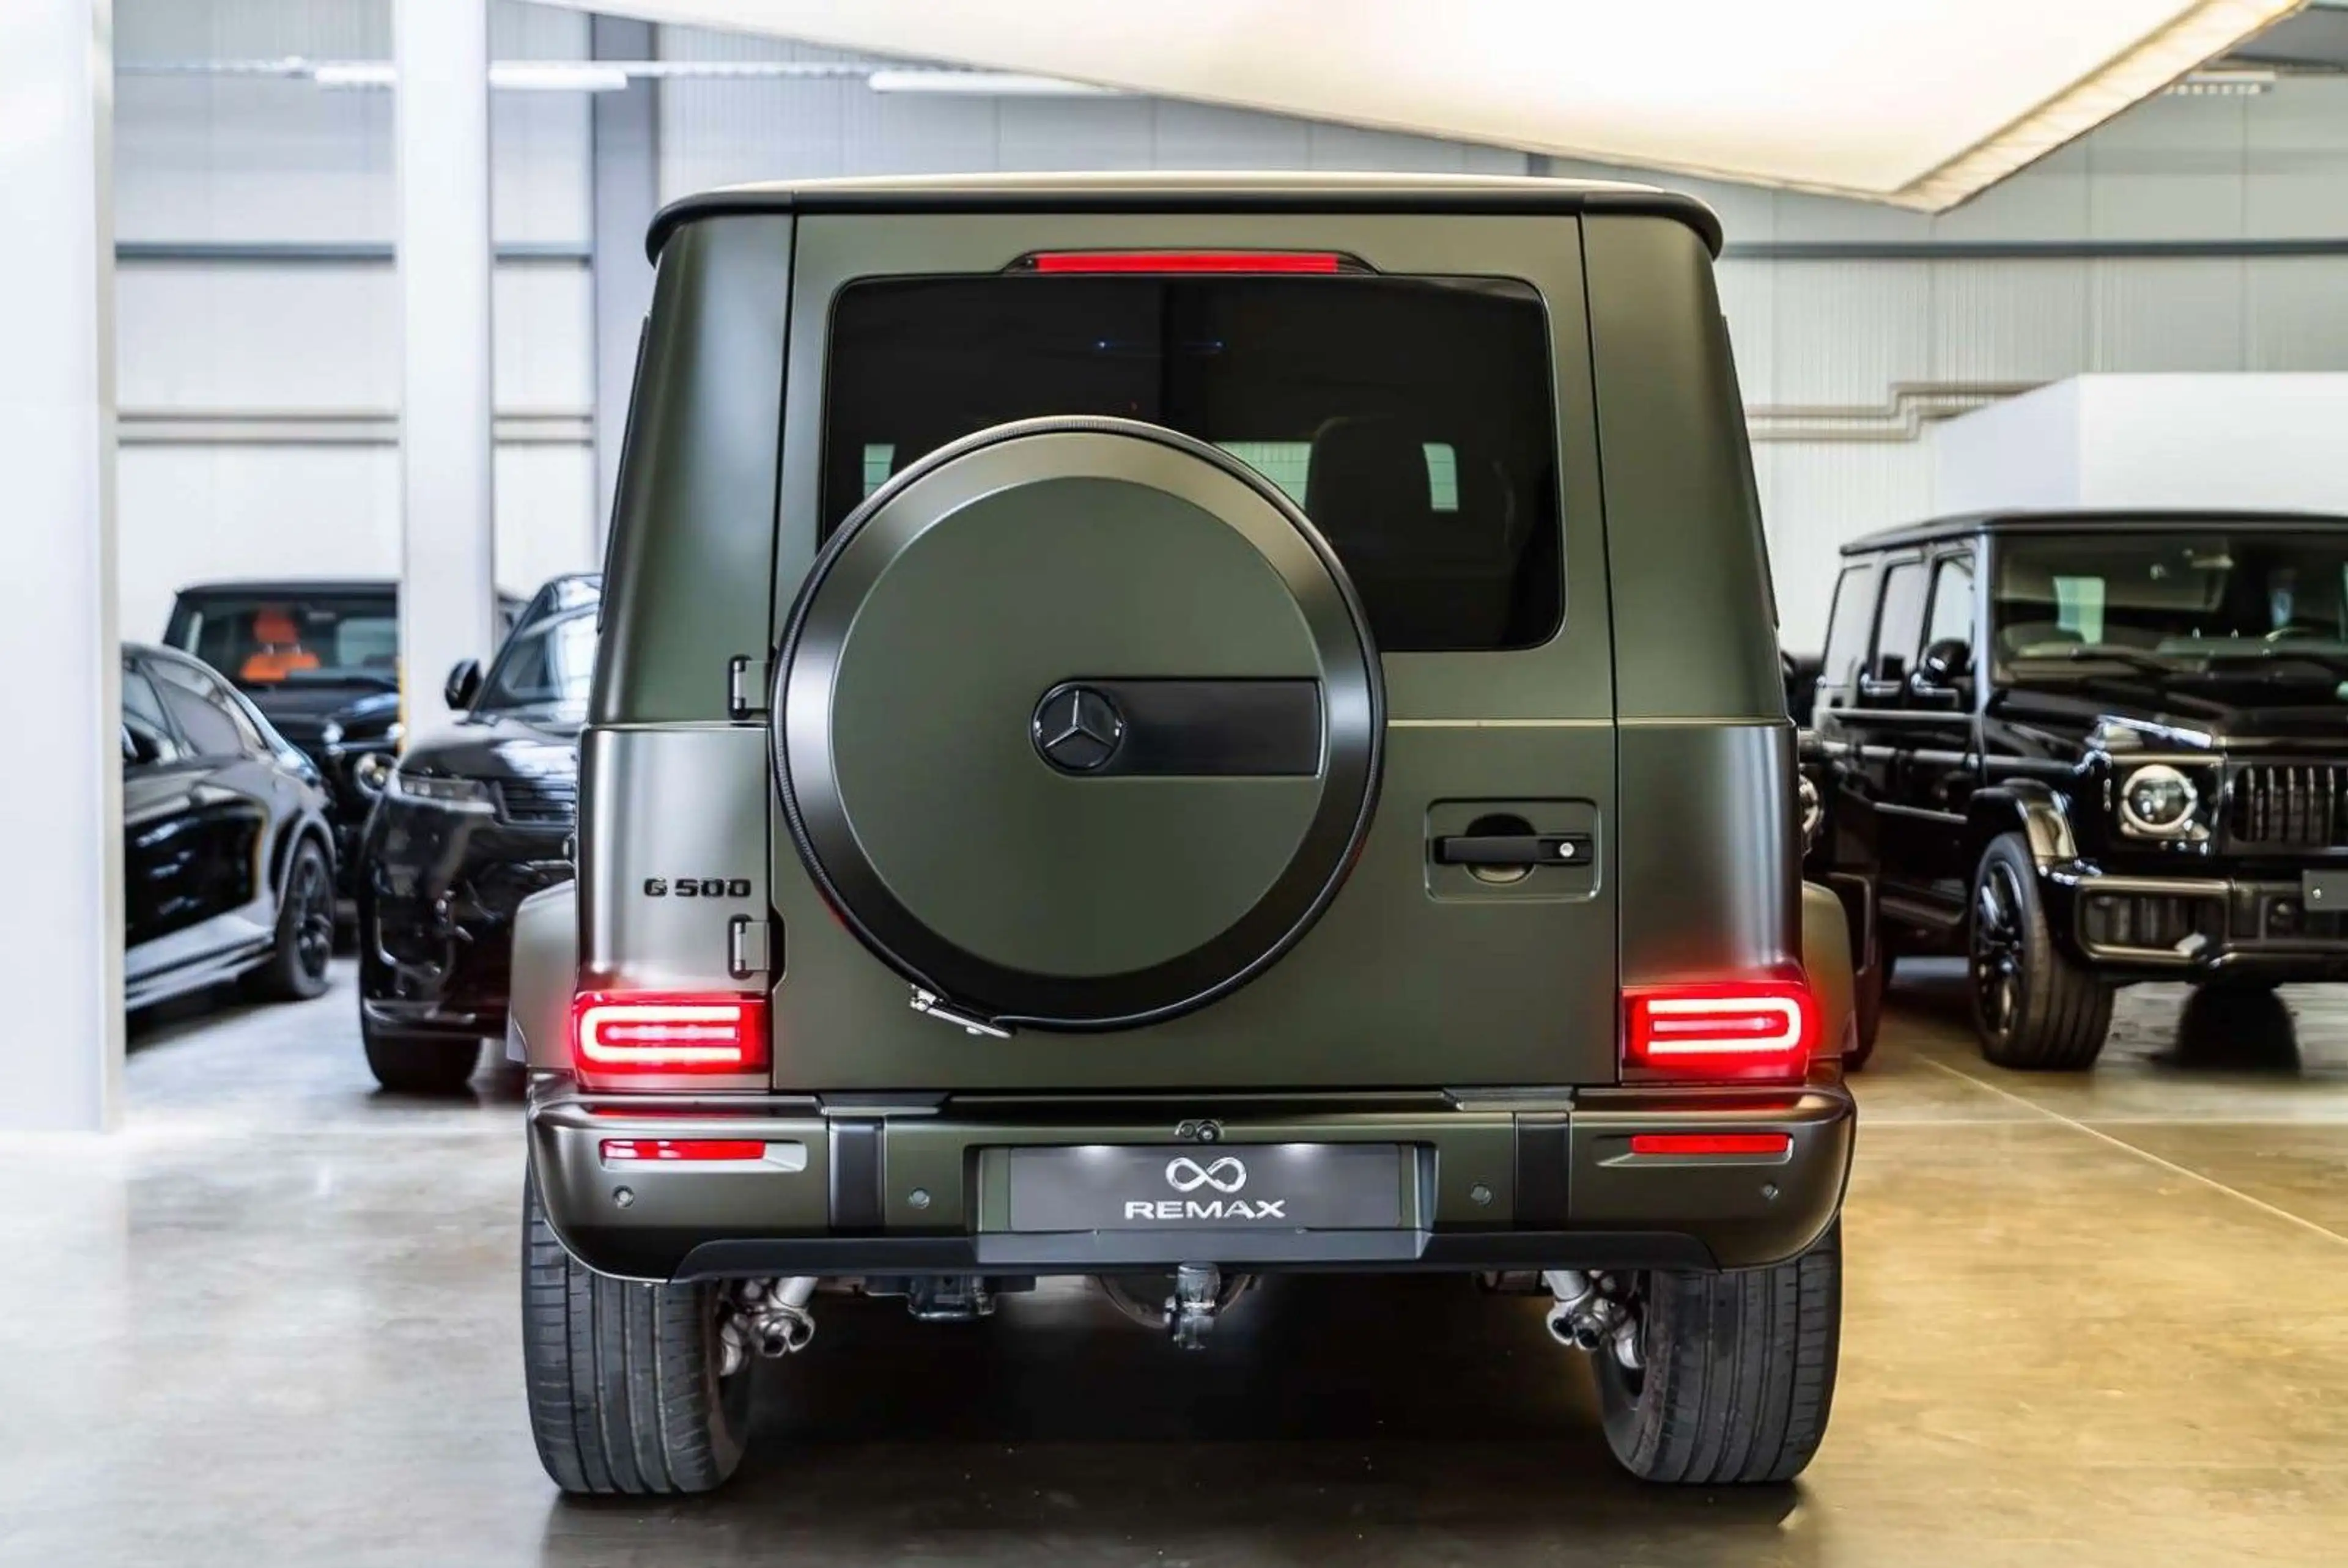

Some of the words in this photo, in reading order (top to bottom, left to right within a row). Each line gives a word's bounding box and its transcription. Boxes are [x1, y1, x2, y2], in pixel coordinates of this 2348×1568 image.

[644, 878, 668, 897] G
[674, 878, 751, 897] 500
[1124, 1200, 1286, 1220] REMAX
